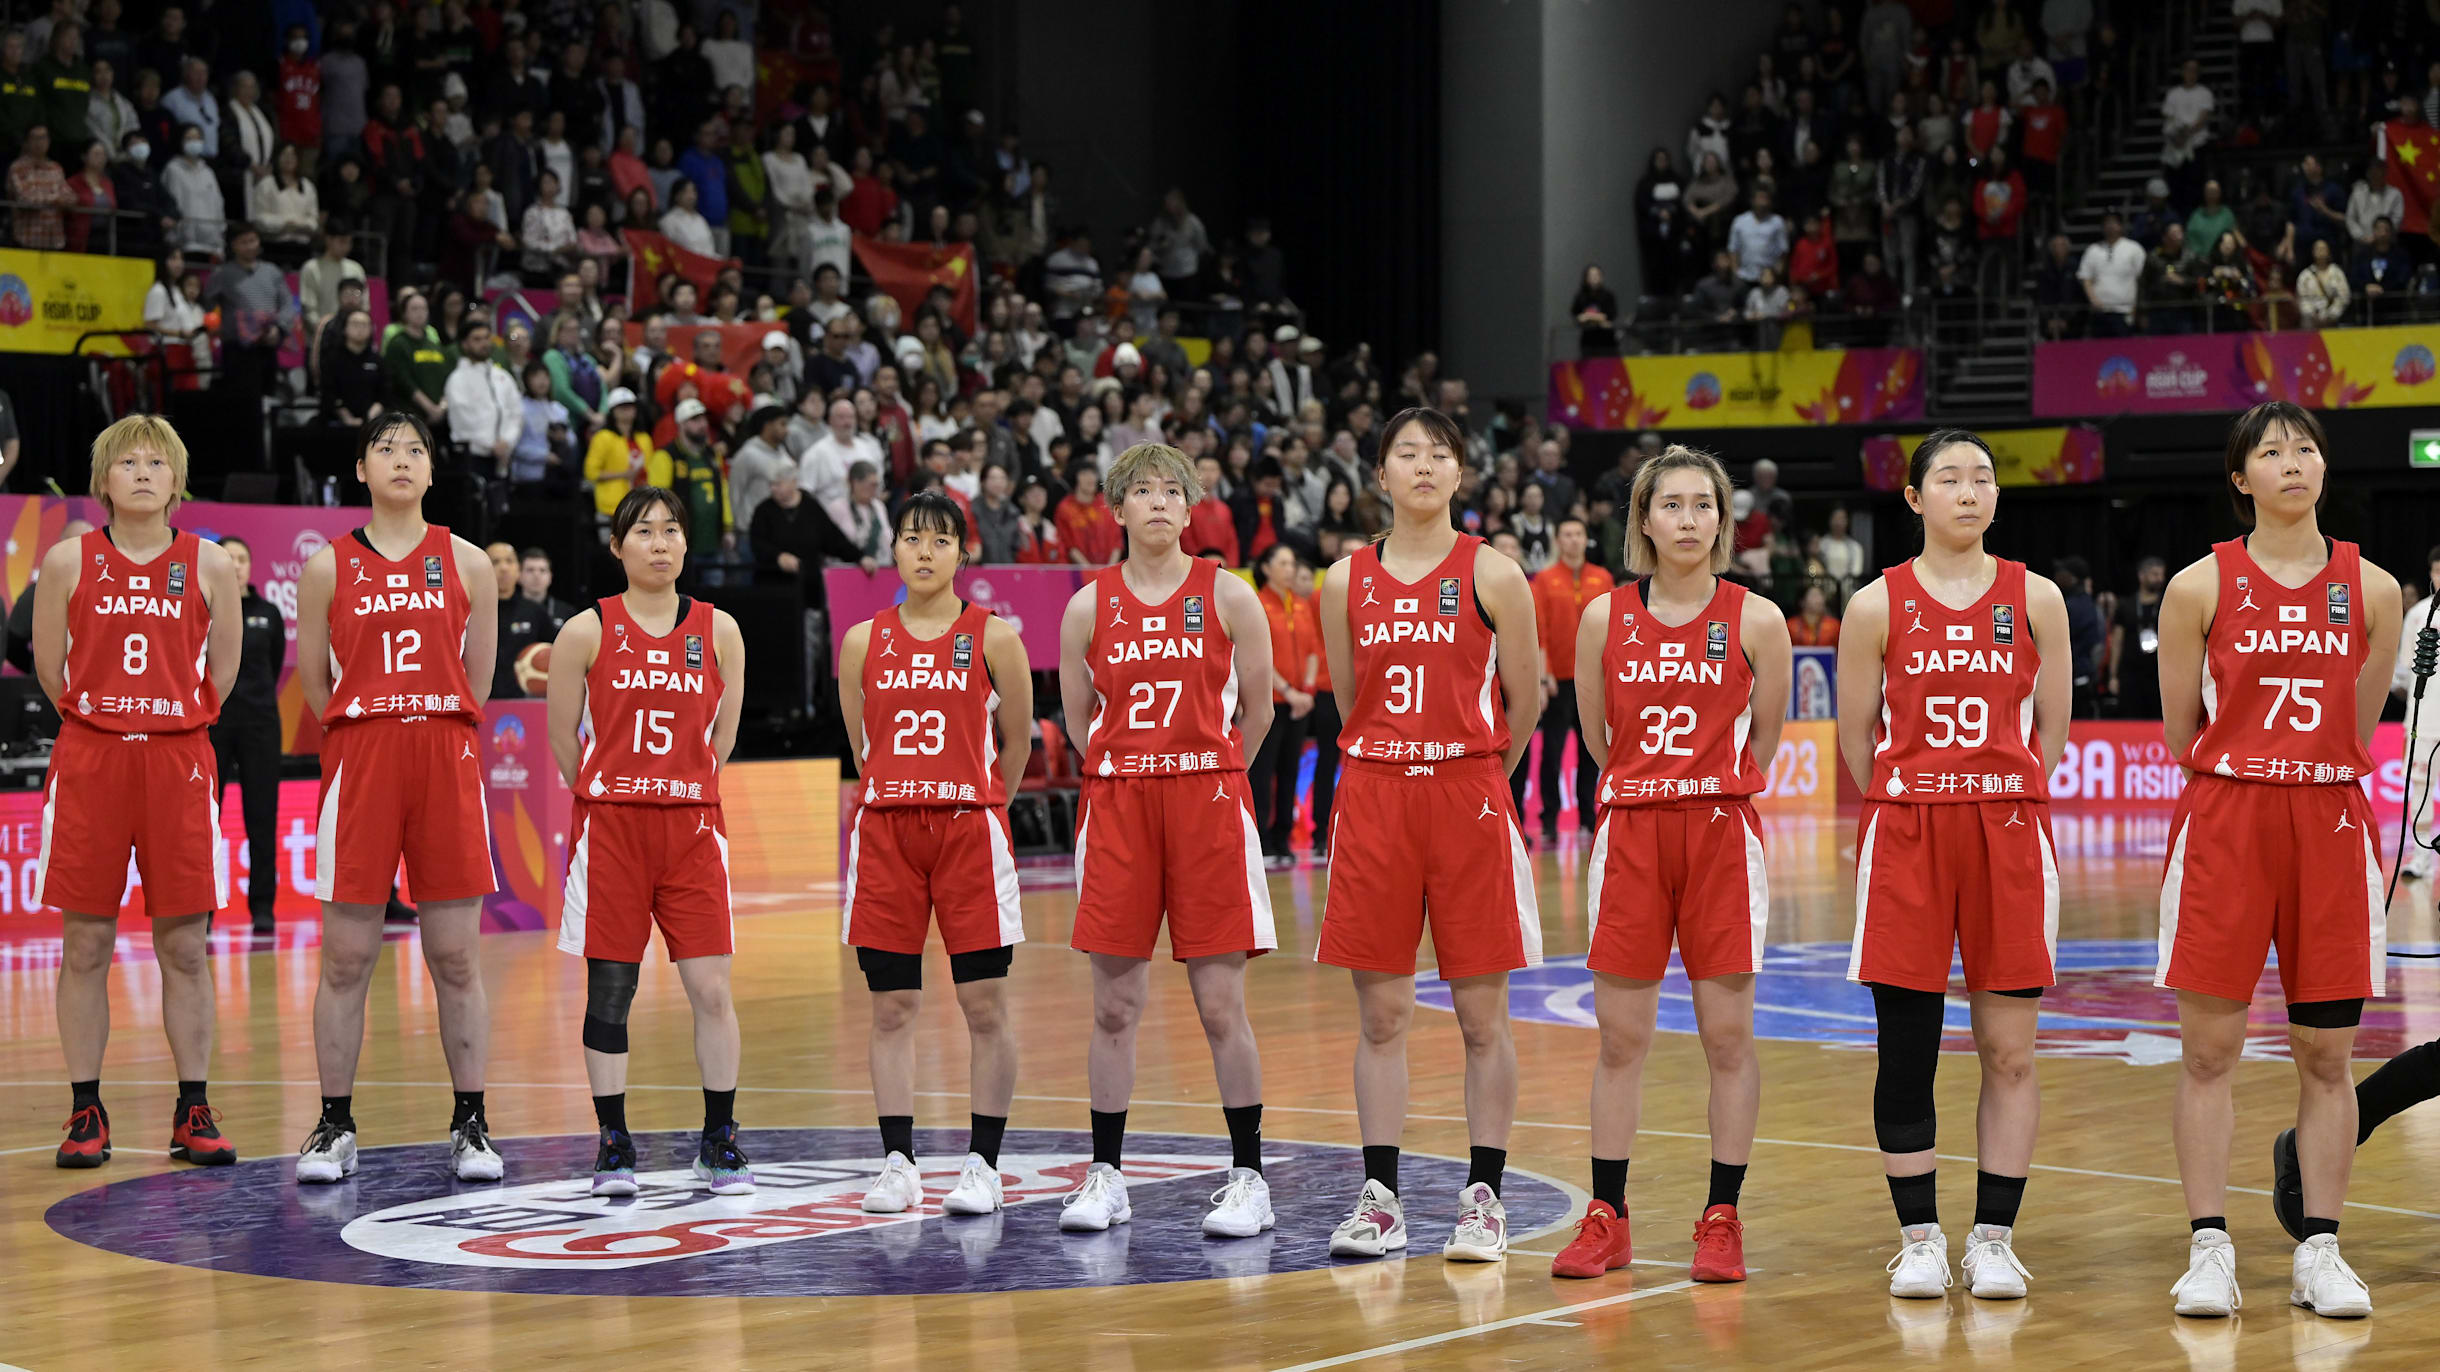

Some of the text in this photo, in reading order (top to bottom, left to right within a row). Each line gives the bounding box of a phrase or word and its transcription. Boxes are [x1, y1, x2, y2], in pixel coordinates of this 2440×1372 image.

[95, 595, 182, 619] JAPAN
[354, 590, 445, 616] JAPAN
[1442, 598, 1456, 607] FIBA
[2331, 606, 2346, 614] FIBA
[1187, 616, 1201, 624] FIBA
[1996, 626, 2011, 635] FIBA
[1359, 621, 1456, 647] JAPAN
[2234, 629, 2349, 656] JAPAN
[123, 633, 148, 676] 8
[381, 629, 422, 675] 12
[1107, 637, 1203, 664] JAPAN
[1709, 643, 1724, 651] FIBA
[1618, 660, 1723, 685] JAPAN
[1904, 649, 2013, 675] JAPAN
[612, 669, 704, 694] JAPAN
[876, 669, 968, 692] JAPAN
[1384, 664, 1425, 714] 31
[101, 695, 186, 718] 三井不動産
[370, 694, 461, 713] 三井不動産
[1128, 680, 1183, 730] 27
[2259, 677, 2324, 732] 75
[632, 708, 675, 755] 15
[893, 709, 946, 756] 23
[1639, 705, 1698, 757] 32
[1925, 695, 1989, 748] 59
[1120, 750, 1220, 773] 三井不動産
[1367, 740, 1466, 761] 三井不動産
[1405, 766, 1434, 776] JPN
[2048, 739, 2115, 799] BA
[2243, 757, 2355, 784] 三井不動産
[613, 776, 703, 800] 三井不動産
[883, 780, 977, 801] 三井不動産
[1620, 775, 1722, 798] 三井不動産
[1914, 772, 2025, 794] 三井不動産
